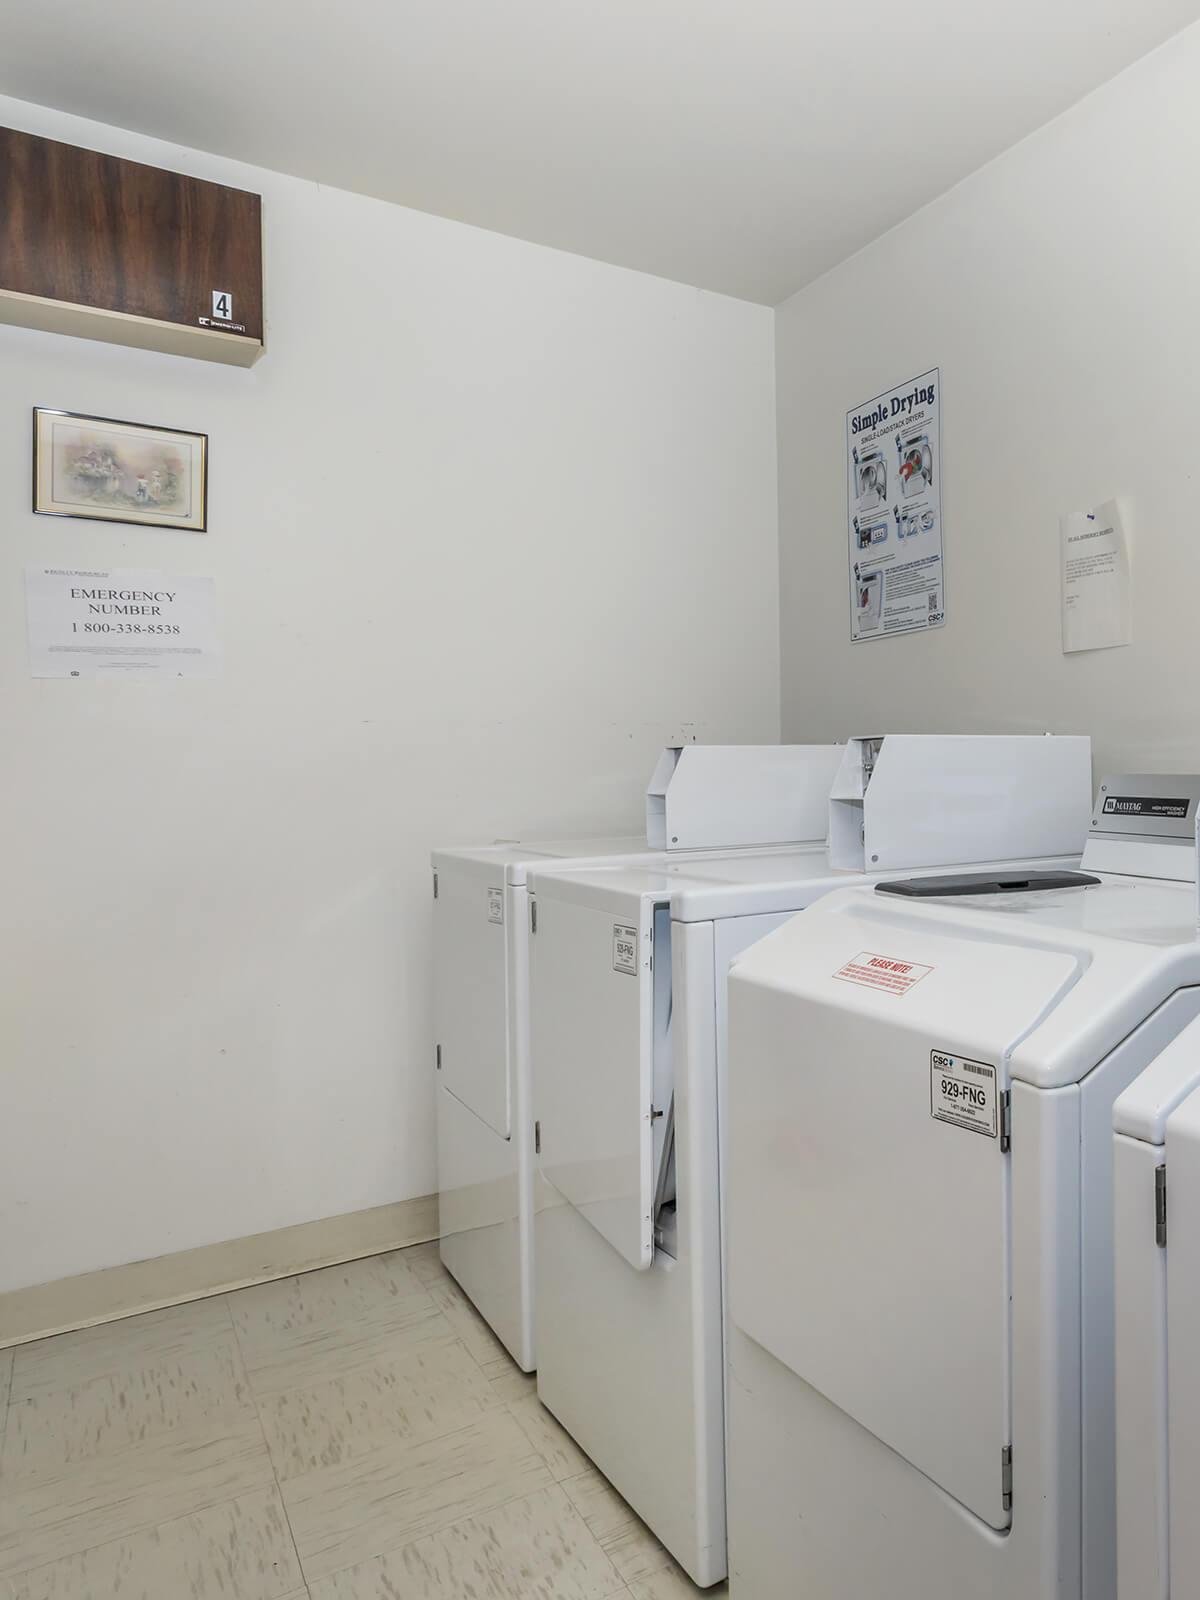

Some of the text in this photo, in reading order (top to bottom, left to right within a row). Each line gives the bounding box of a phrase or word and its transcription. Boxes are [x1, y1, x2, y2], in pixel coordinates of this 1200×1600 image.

[216, 295, 229, 317] 4
[852, 404, 888, 434] Simple
[891, 384, 934, 414] Drying
[71, 589, 176, 602] EMERGENCY
[89, 604, 161, 616] NUMBER
[928, 613, 940, 621] CSC
[72, 623, 180, 634] 1 800-338-8538
[1116, 802, 1142, 811] MAYTAG
[867, 958, 913, 974] PLEASE NOTE!
[933, 1055, 948, 1066] CSC
[941, 1080, 986, 1106] 929-FNG
